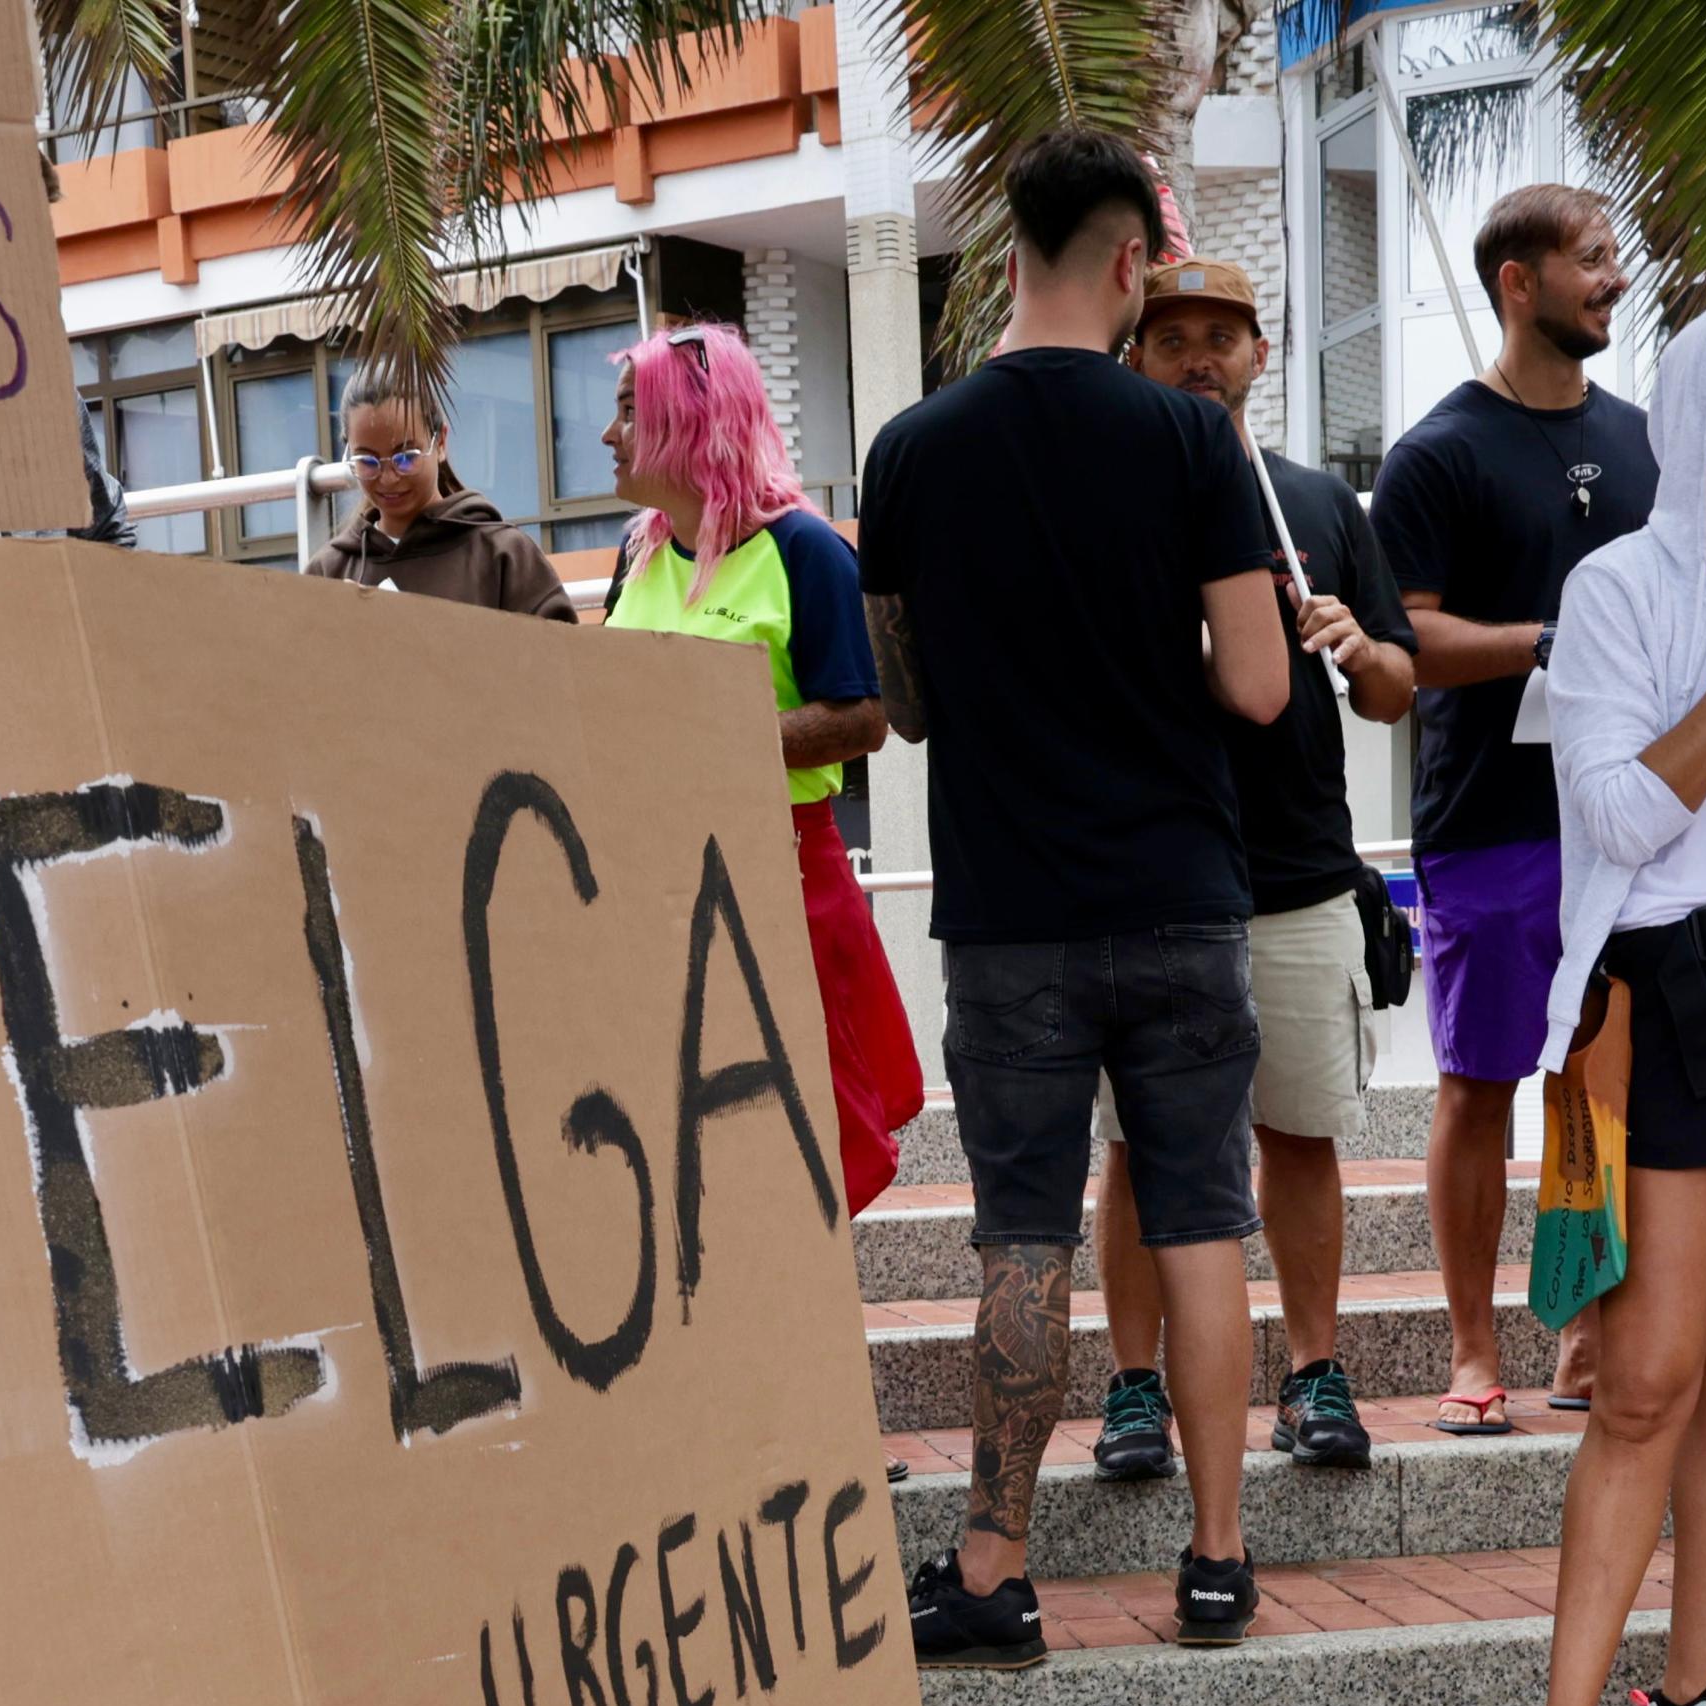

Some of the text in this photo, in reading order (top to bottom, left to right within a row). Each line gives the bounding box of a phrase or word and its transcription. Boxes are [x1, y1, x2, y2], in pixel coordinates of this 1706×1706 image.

[1581, 1209, 1592, 1239] LOS
[1546, 1180, 1574, 1310] CONVENIO
[1191, 1589, 1235, 1602] Reebok
